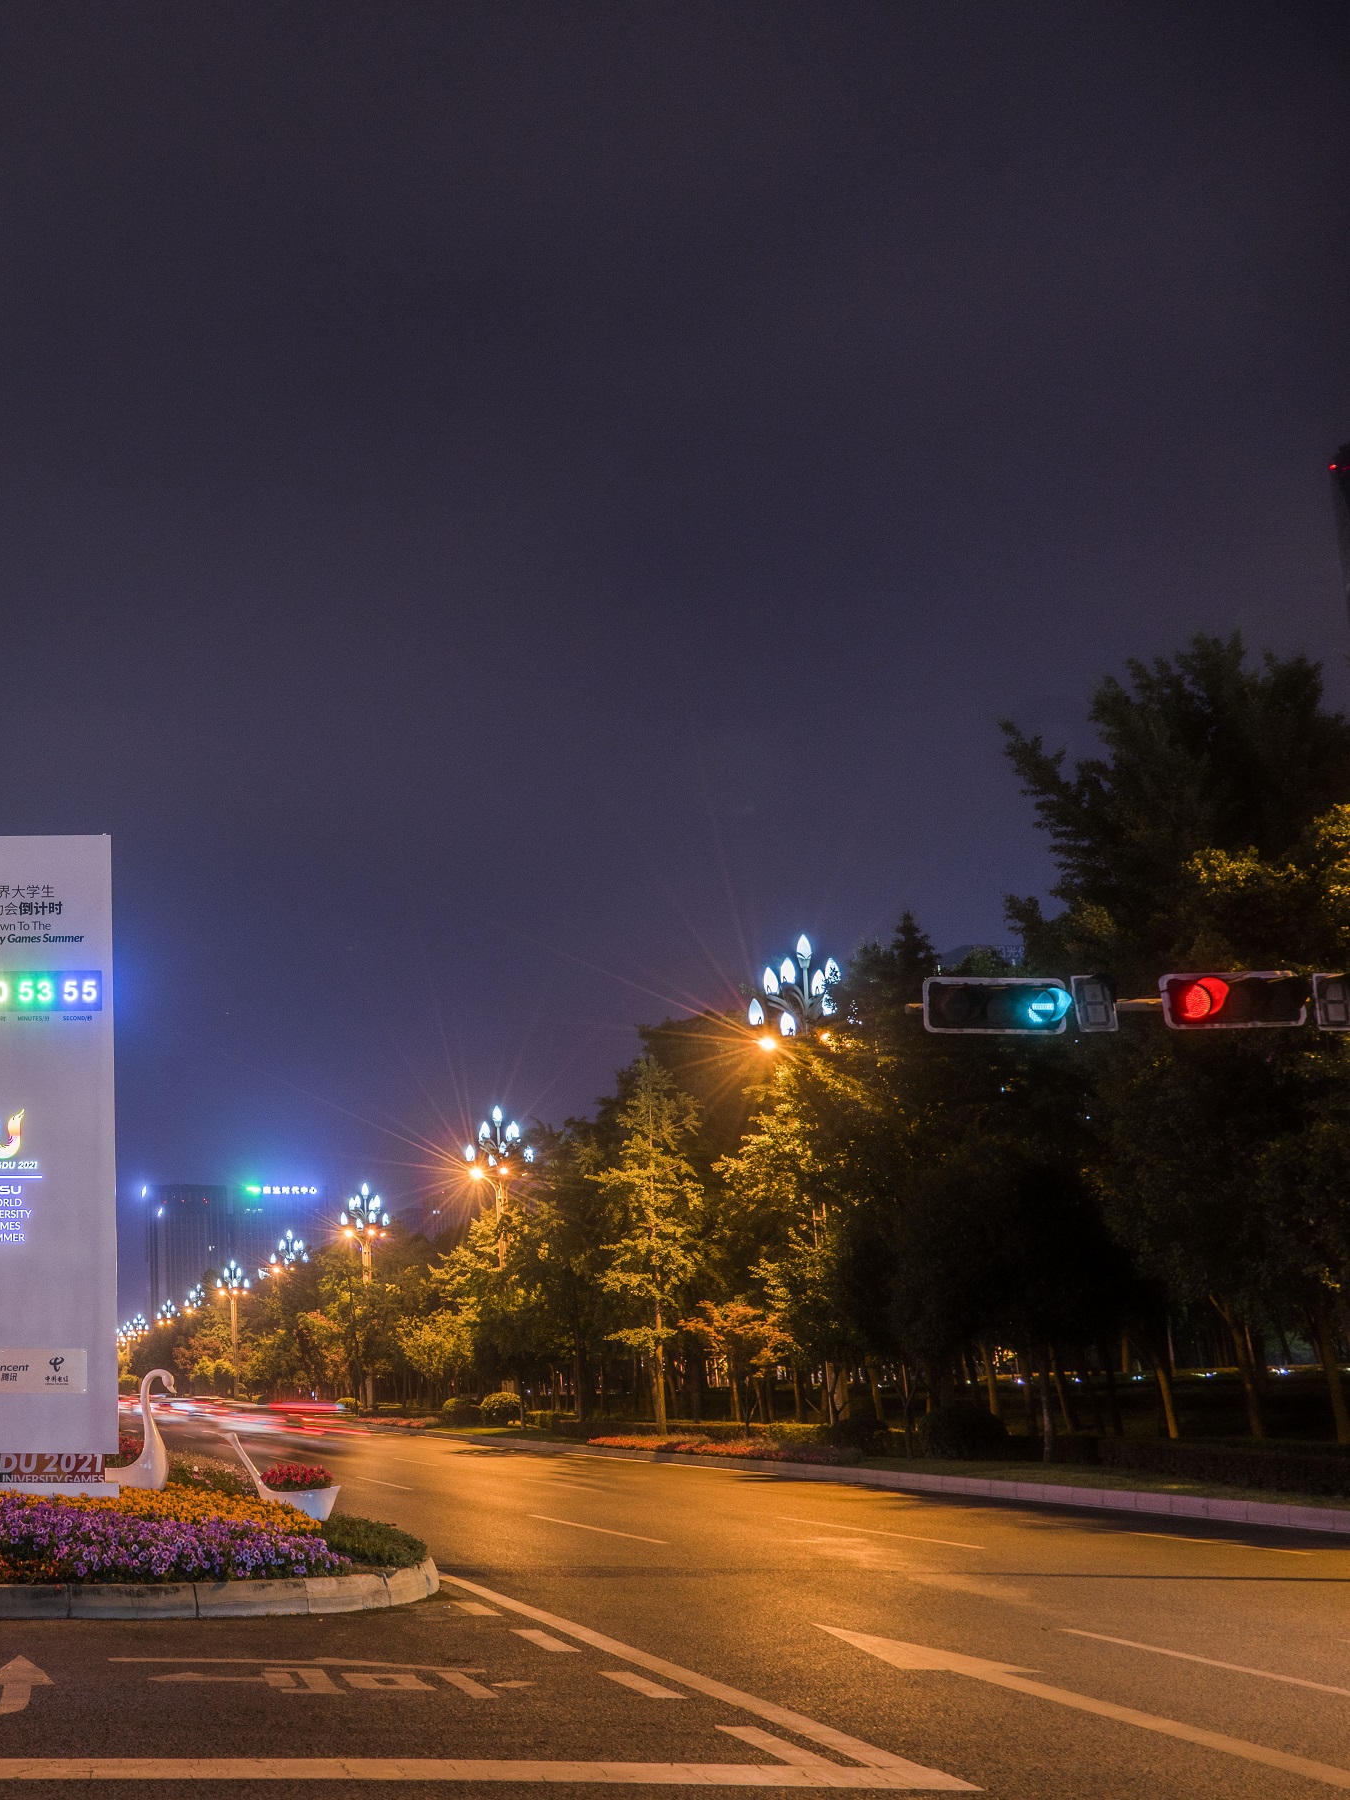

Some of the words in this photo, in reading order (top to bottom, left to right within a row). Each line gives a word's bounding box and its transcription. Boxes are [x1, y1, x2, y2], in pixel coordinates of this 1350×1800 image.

[17, 921, 30, 931] To
[31, 920, 52, 931] The
[7, 933, 41, 943] Games
[42, 933, 84, 943] Summer
[19, 980, 52, 1001] 53
[63, 980, 97, 1001] 55
[17, 1161, 38, 1169] 2021
[0, 1372, 17, 1382] 腾讯
[43, 1453, 104, 1473] 2021
[0, 1474, 63, 1482] UNIVERSITY
[64, 1474, 105, 1483] GAMES
